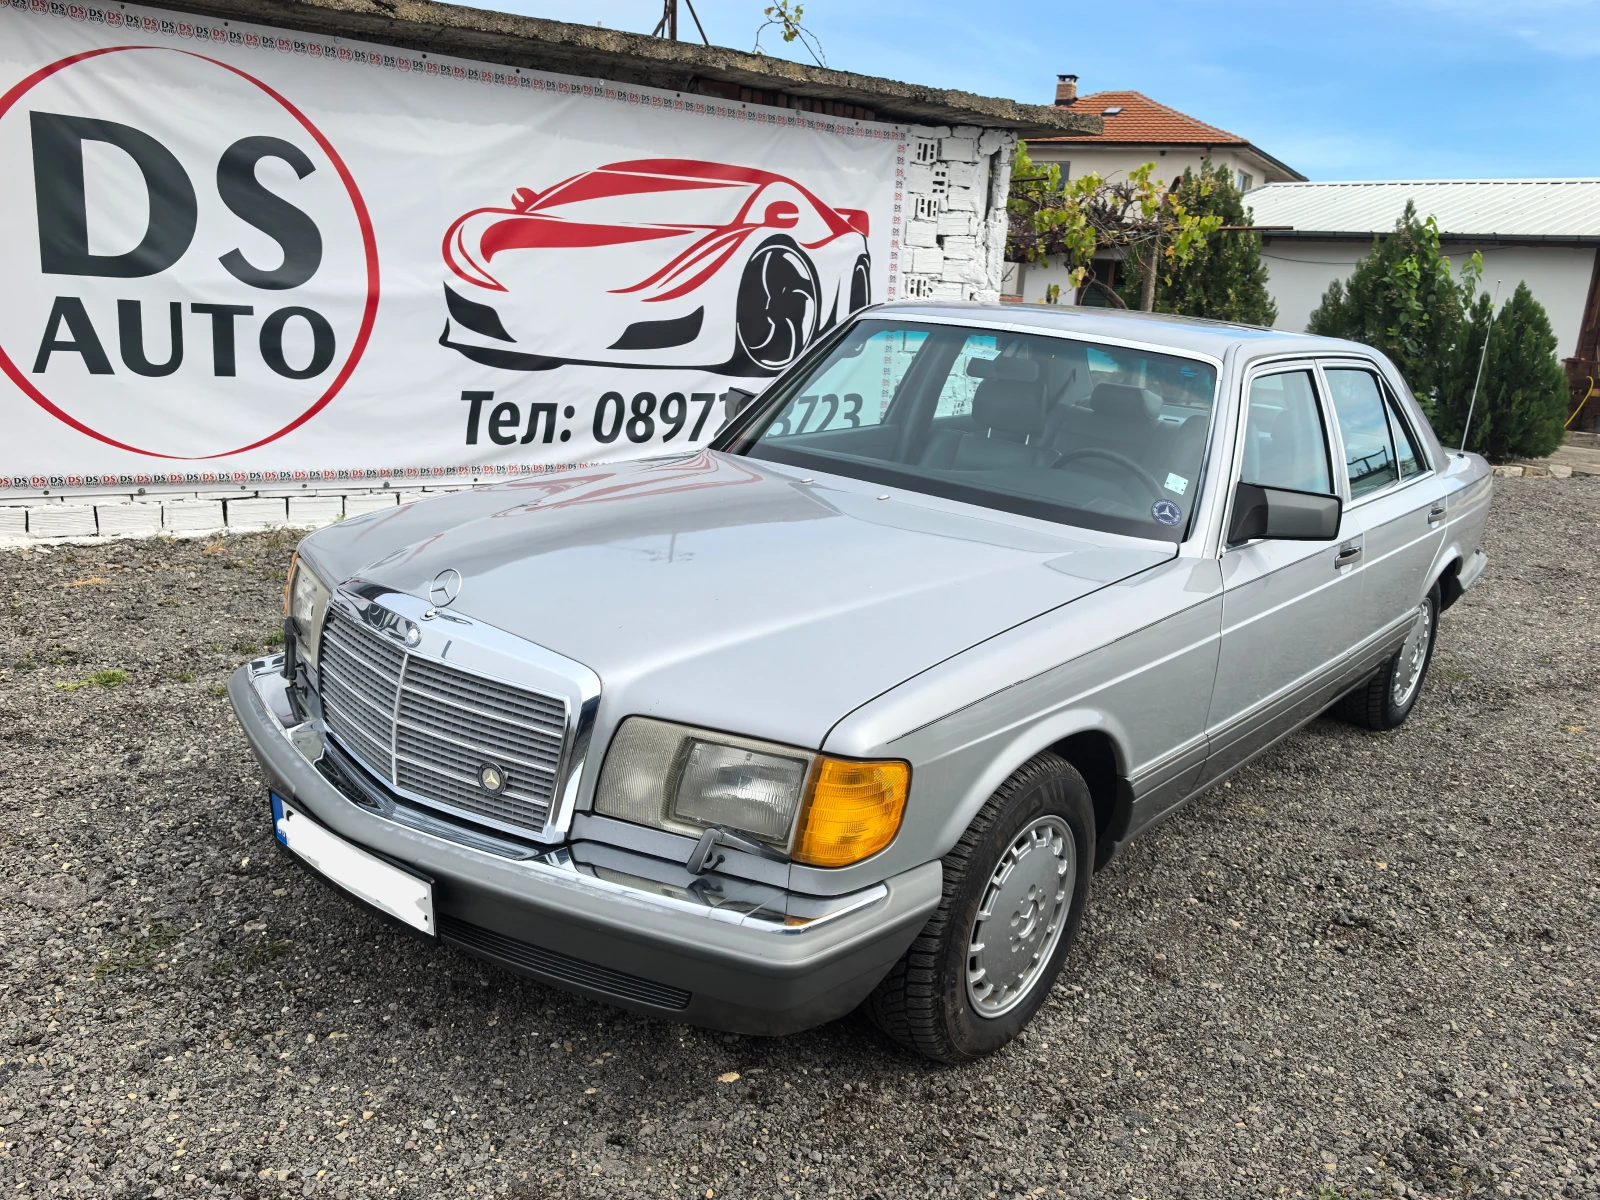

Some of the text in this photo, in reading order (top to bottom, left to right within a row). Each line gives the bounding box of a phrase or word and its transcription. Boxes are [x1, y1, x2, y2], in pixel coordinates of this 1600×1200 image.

[51, 2, 64, 11] DS
[70, 5, 83, 14] DS
[89, 8, 102, 18] DS
[107, 11, 120, 20] DS
[126, 14, 138, 23] DS
[144, 17, 156, 26] DS
[161, 20, 174, 29] DS
[179, 23, 191, 32] DS
[196, 26, 208, 35] DS
[213, 28, 224, 37] DS
[229, 31, 241, 40] DS
[246, 34, 257, 42] DS
[262, 36, 273, 44] DS
[278, 39, 289, 47] DS
[294, 41, 305, 49] DS
[309, 43, 320, 52] DS
[324, 46, 335, 54] DS
[339, 48, 350, 57] DS
[354, 51, 365, 59] DS
[369, 53, 380, 61] DS
[384, 55, 394, 63] DS
[30, 110, 323, 290] DS
[32, 296, 336, 380] AUTO
[460, 390, 576, 445] Тел:
